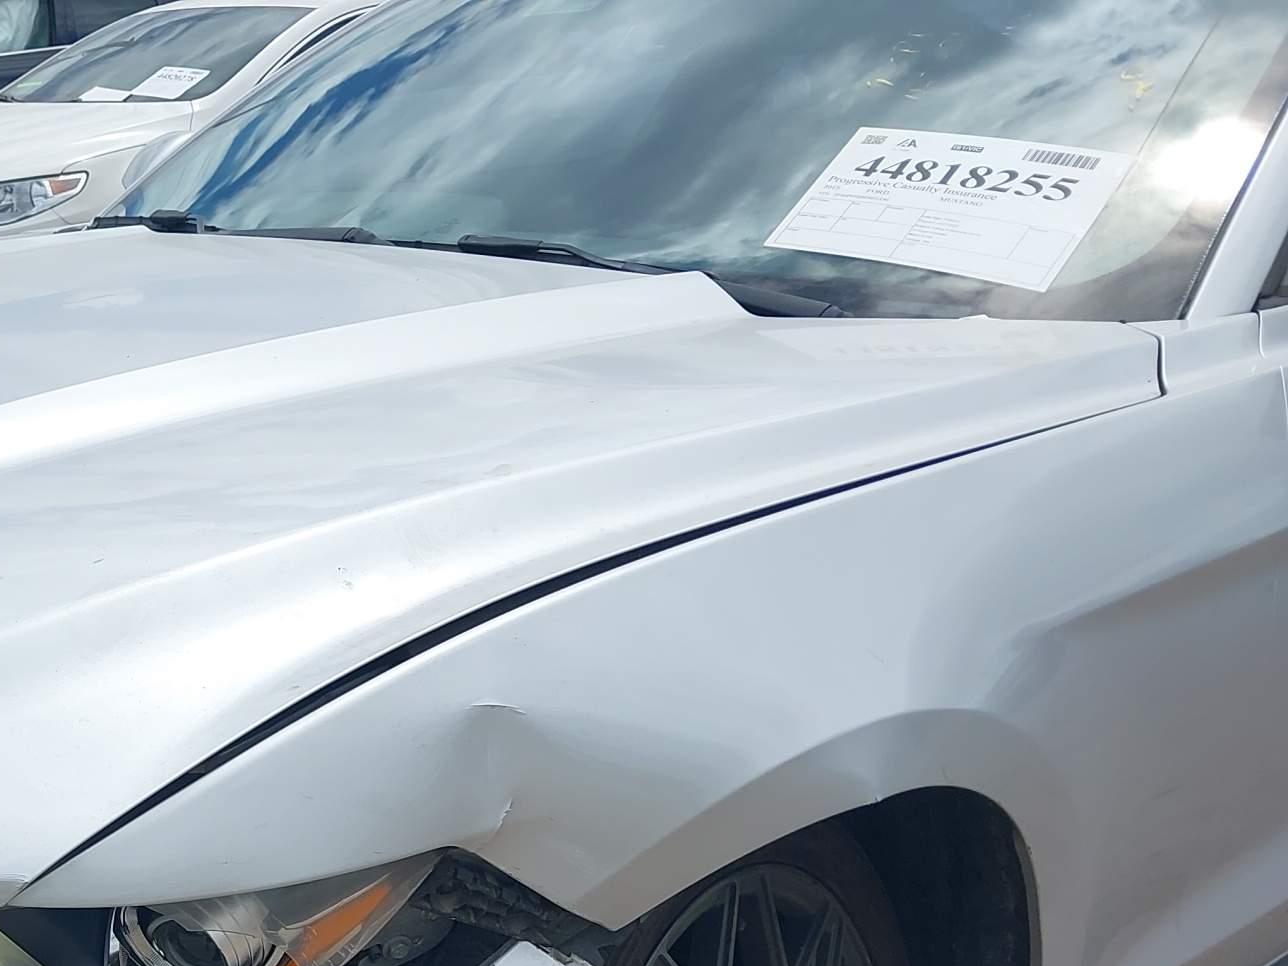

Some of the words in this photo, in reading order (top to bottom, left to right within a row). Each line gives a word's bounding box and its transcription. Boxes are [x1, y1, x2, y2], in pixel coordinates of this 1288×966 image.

[828, 175, 891, 189] Progressive
[892, 181, 938, 194] Casualty
[943, 187, 999, 201] Insurance
[854, 155, 1081, 202] 44818255
